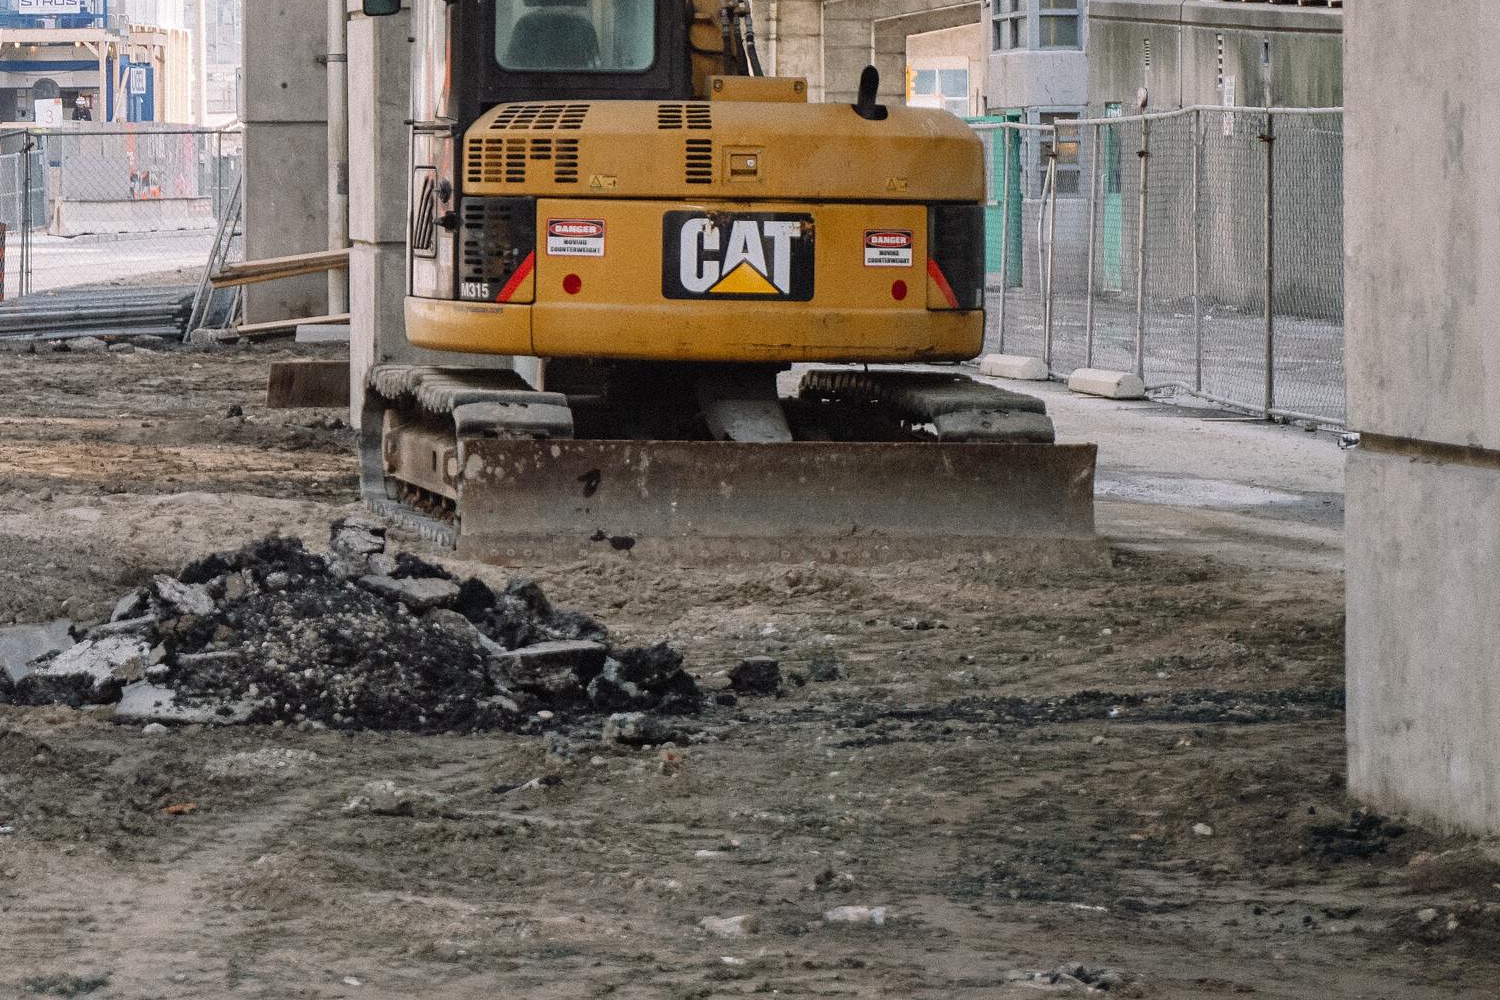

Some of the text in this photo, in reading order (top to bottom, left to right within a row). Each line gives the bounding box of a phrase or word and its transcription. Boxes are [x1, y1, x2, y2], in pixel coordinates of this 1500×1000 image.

[44, 109, 54, 124] 3
[555, 225, 597, 233] DANGER
[871, 236, 907, 244] DANGER
[680, 218, 801, 294] CAT
[460, 282, 489, 298] M315
